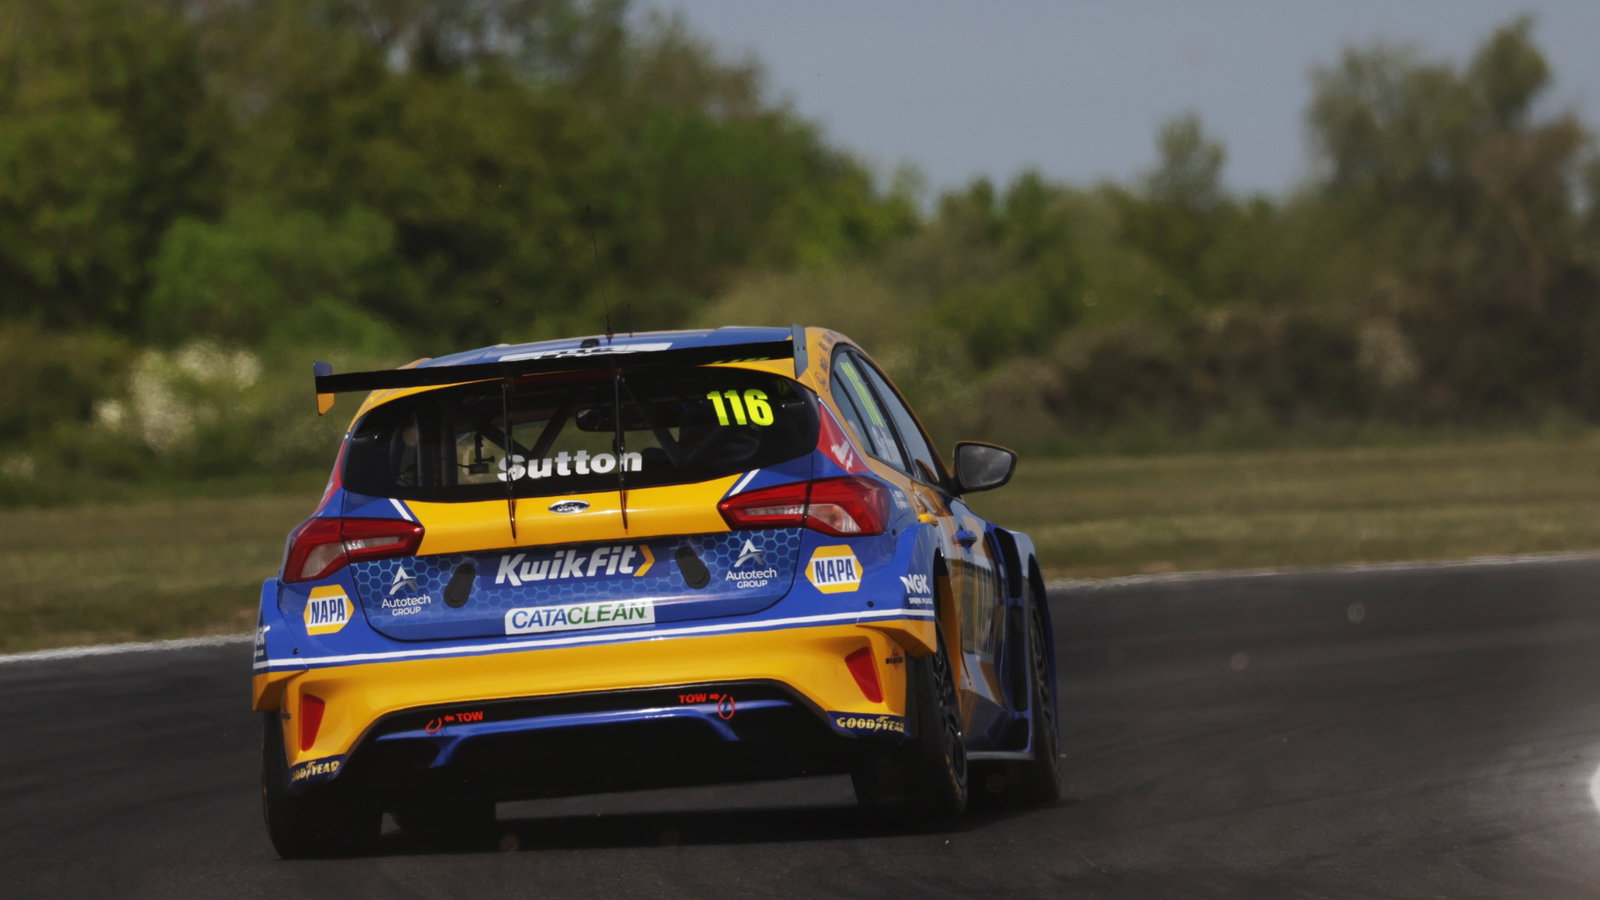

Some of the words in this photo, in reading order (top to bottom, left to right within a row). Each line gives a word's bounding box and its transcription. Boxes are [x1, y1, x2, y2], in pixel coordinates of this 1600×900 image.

[706, 389, 774, 426] 116
[497, 450, 643, 482] Sutton
[725, 568, 777, 581] Autotech
[815, 558, 856, 583] NAPA
[737, 579, 768, 589] GROUP
[899, 574, 931, 594] NGK
[381, 594, 431, 609] Autotech
[311, 597, 345, 624] NAPA
[392, 606, 422, 616] GROUP
[512, 602, 645, 629] CATACLEAN
[678, 693, 707, 704] TOW
[455, 711, 484, 722] TOW
